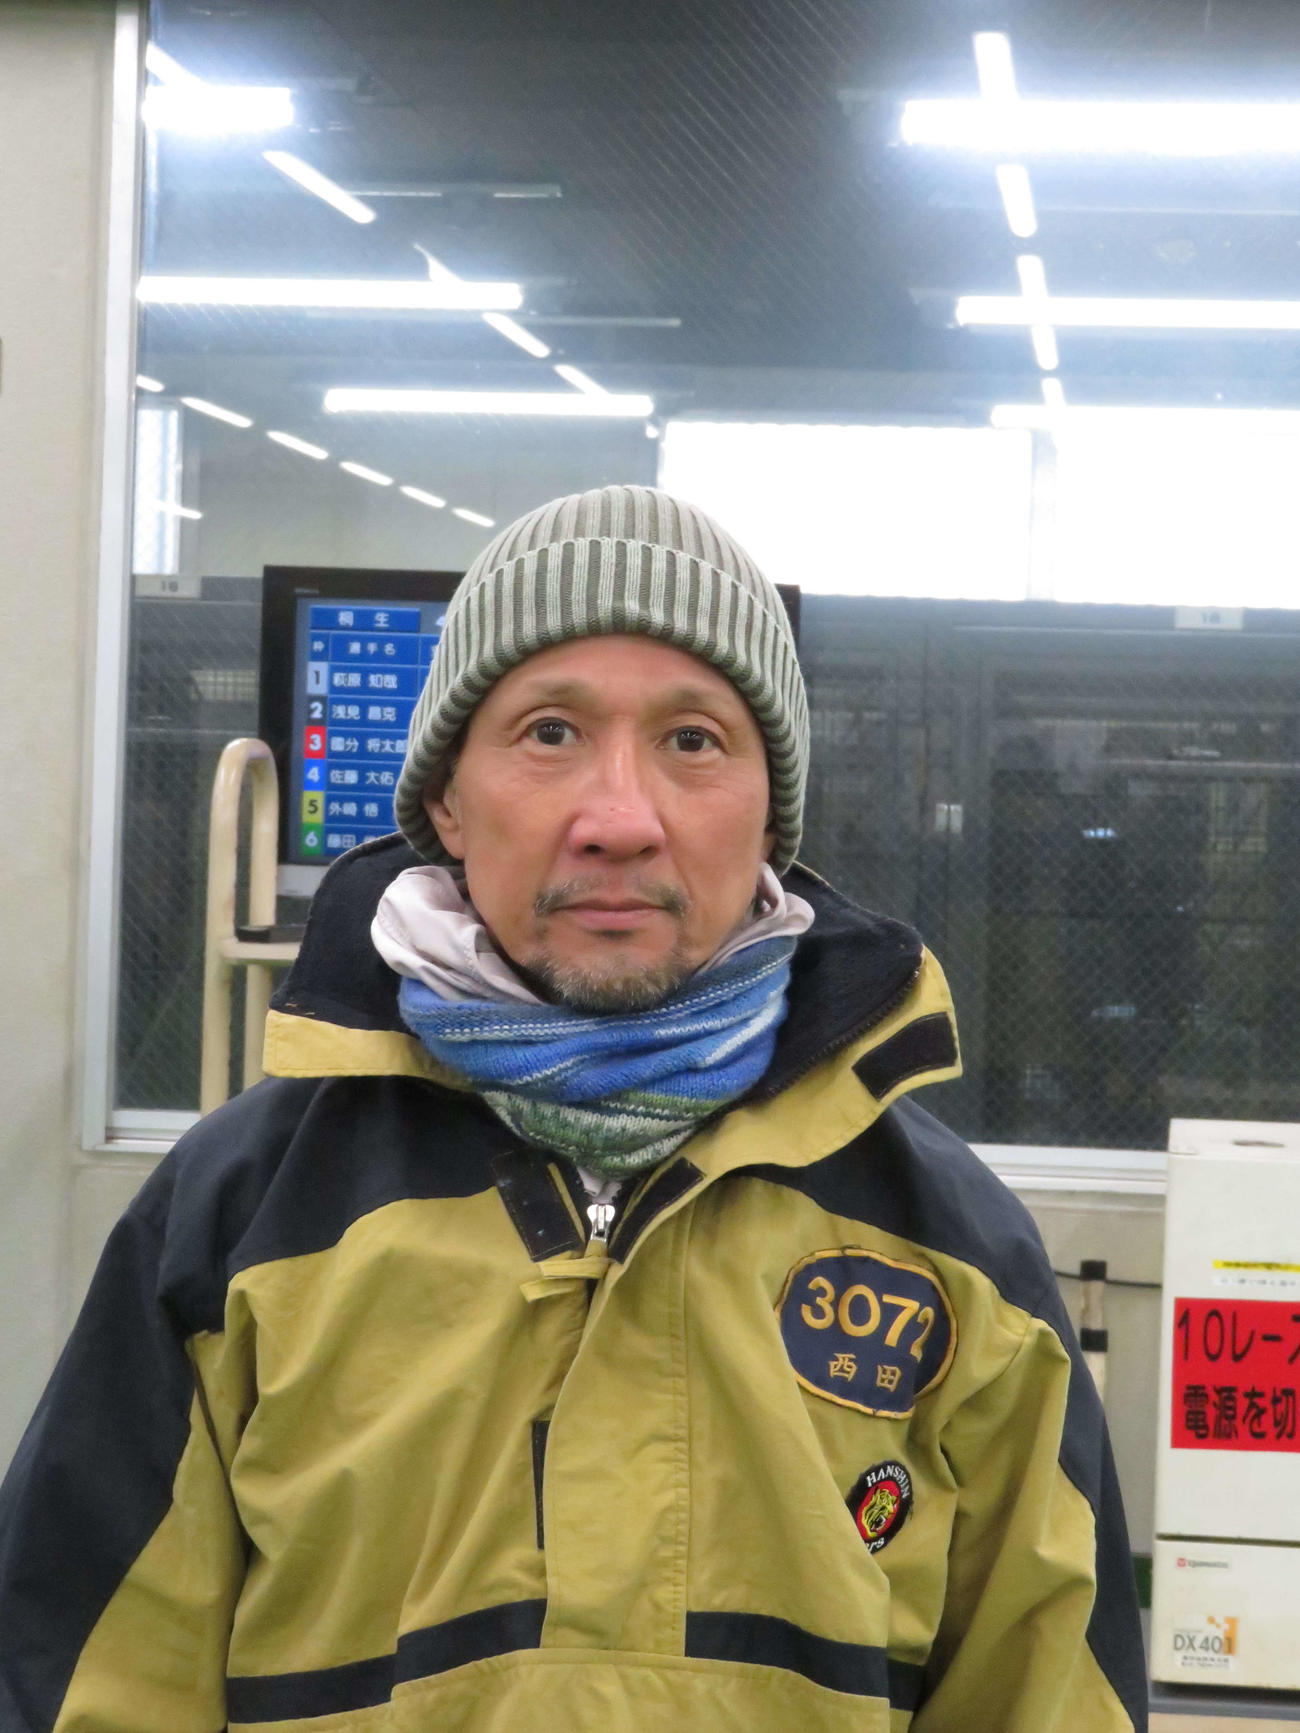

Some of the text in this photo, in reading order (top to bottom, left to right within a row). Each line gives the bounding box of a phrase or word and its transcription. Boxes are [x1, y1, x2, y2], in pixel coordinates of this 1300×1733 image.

[313, 670, 321, 686] 1
[310, 701, 323, 719] 2
[309, 733, 322, 751] 3
[306, 766, 321, 783] 4
[307, 799, 318, 814] 5
[305, 831, 318, 847] 6
[801, 1276, 935, 1363] 3072
[828, 1352, 902, 1392] 西田
[1183, 1385, 1297, 1440] 電源を切
[866, 1465, 911, 1499] HANSHIN
